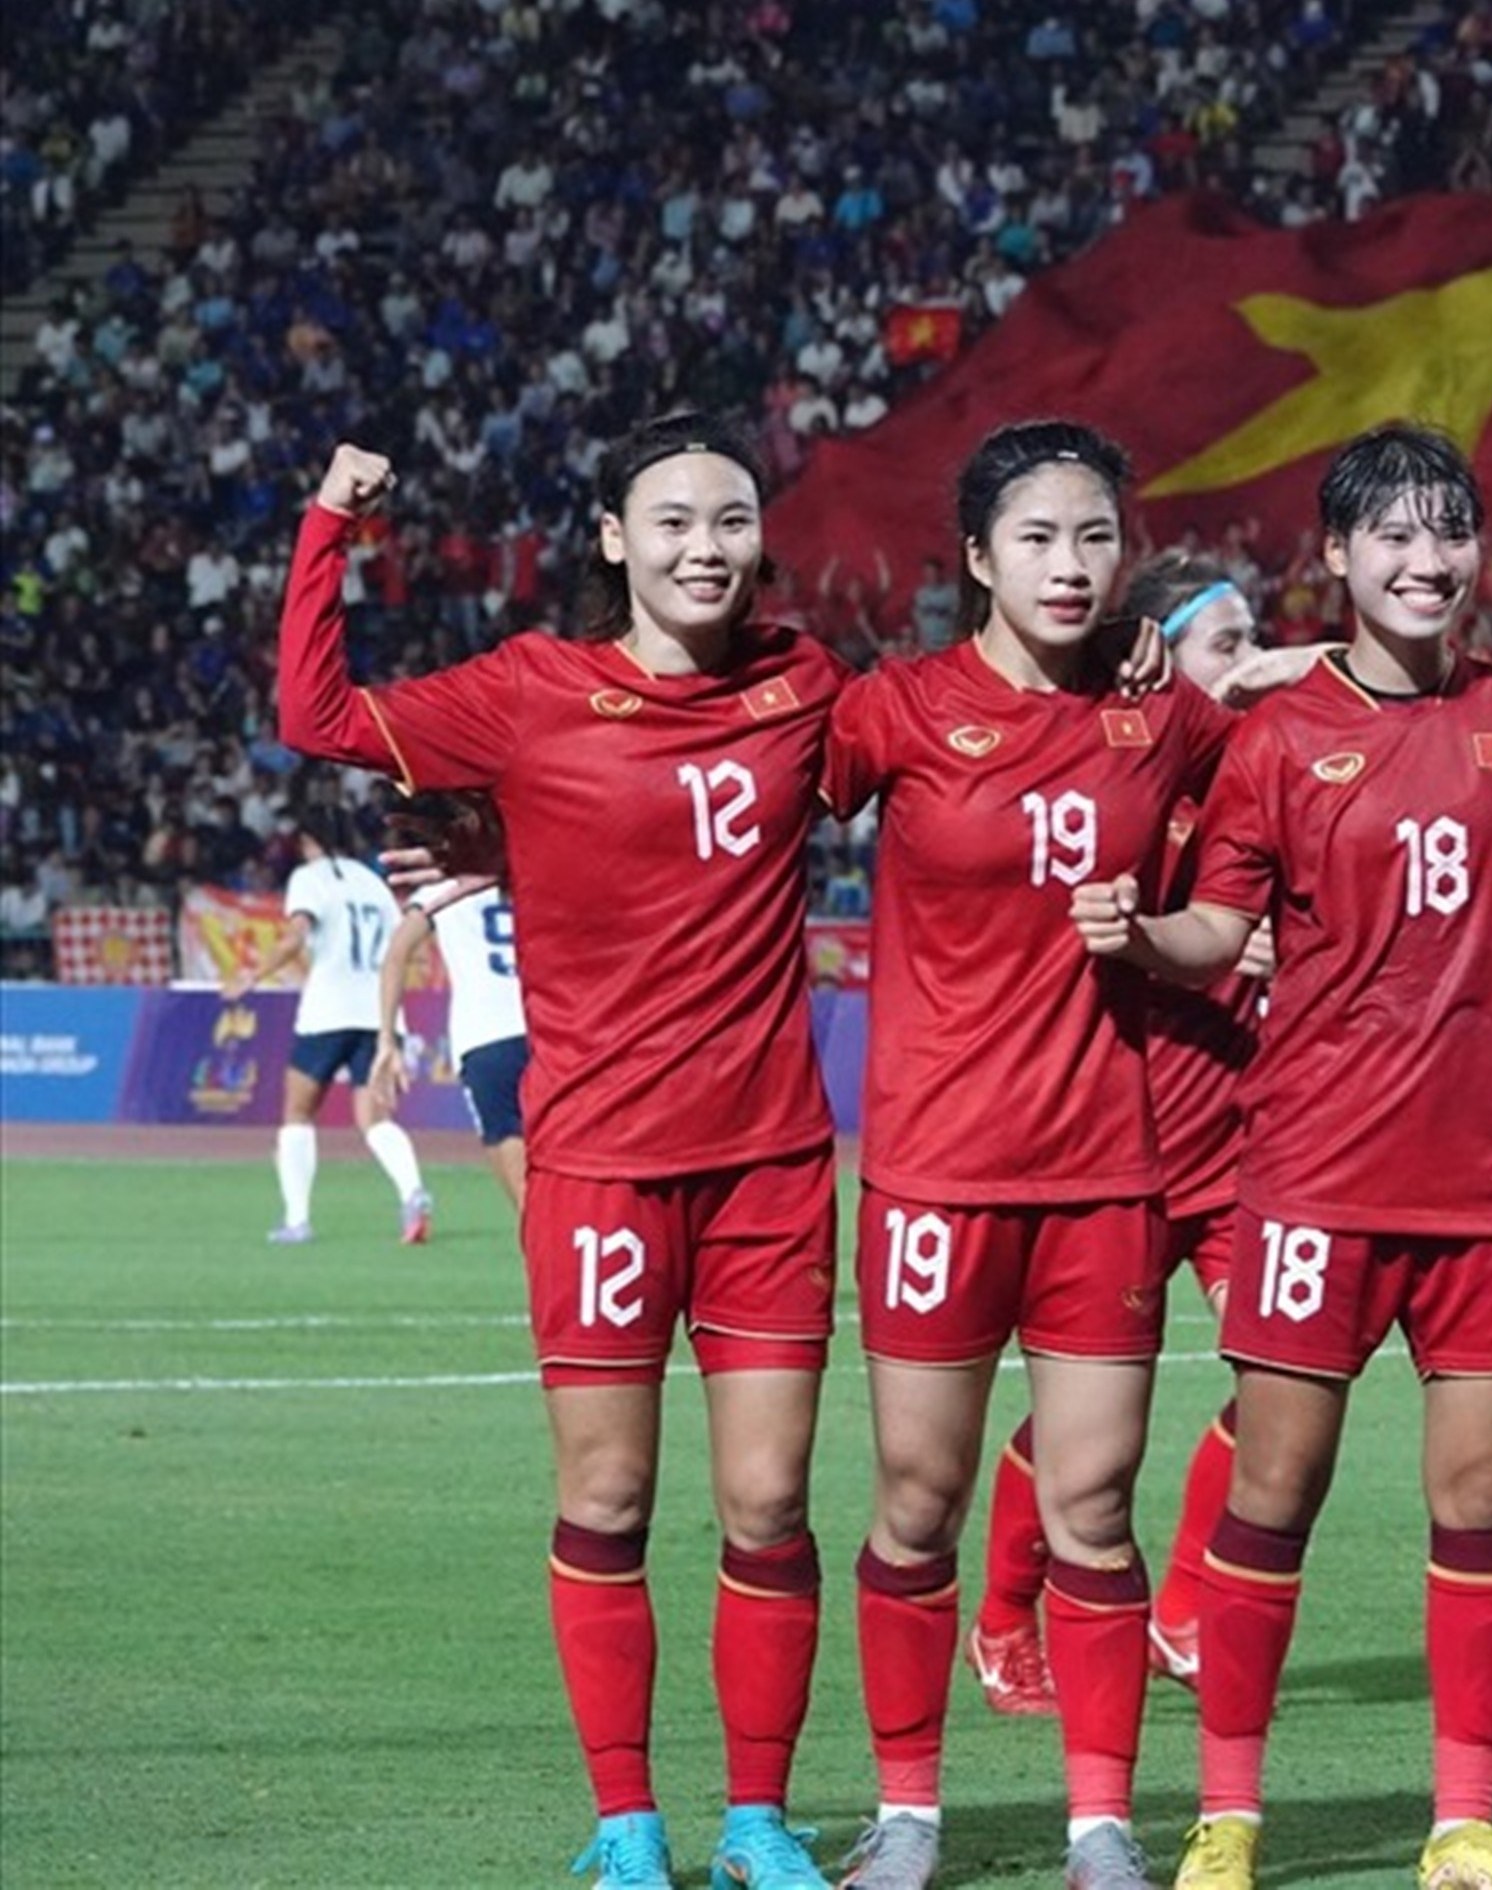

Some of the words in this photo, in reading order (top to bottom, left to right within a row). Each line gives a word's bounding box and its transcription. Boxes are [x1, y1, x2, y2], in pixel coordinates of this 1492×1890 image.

[677, 759, 759, 860] 12
[1021, 789, 1097, 886] 19
[1396, 815, 1469, 916] 18
[573, 1225, 644, 1327] 12
[885, 1208, 951, 1314] 19
[1259, 1220, 1331, 1322] 18
